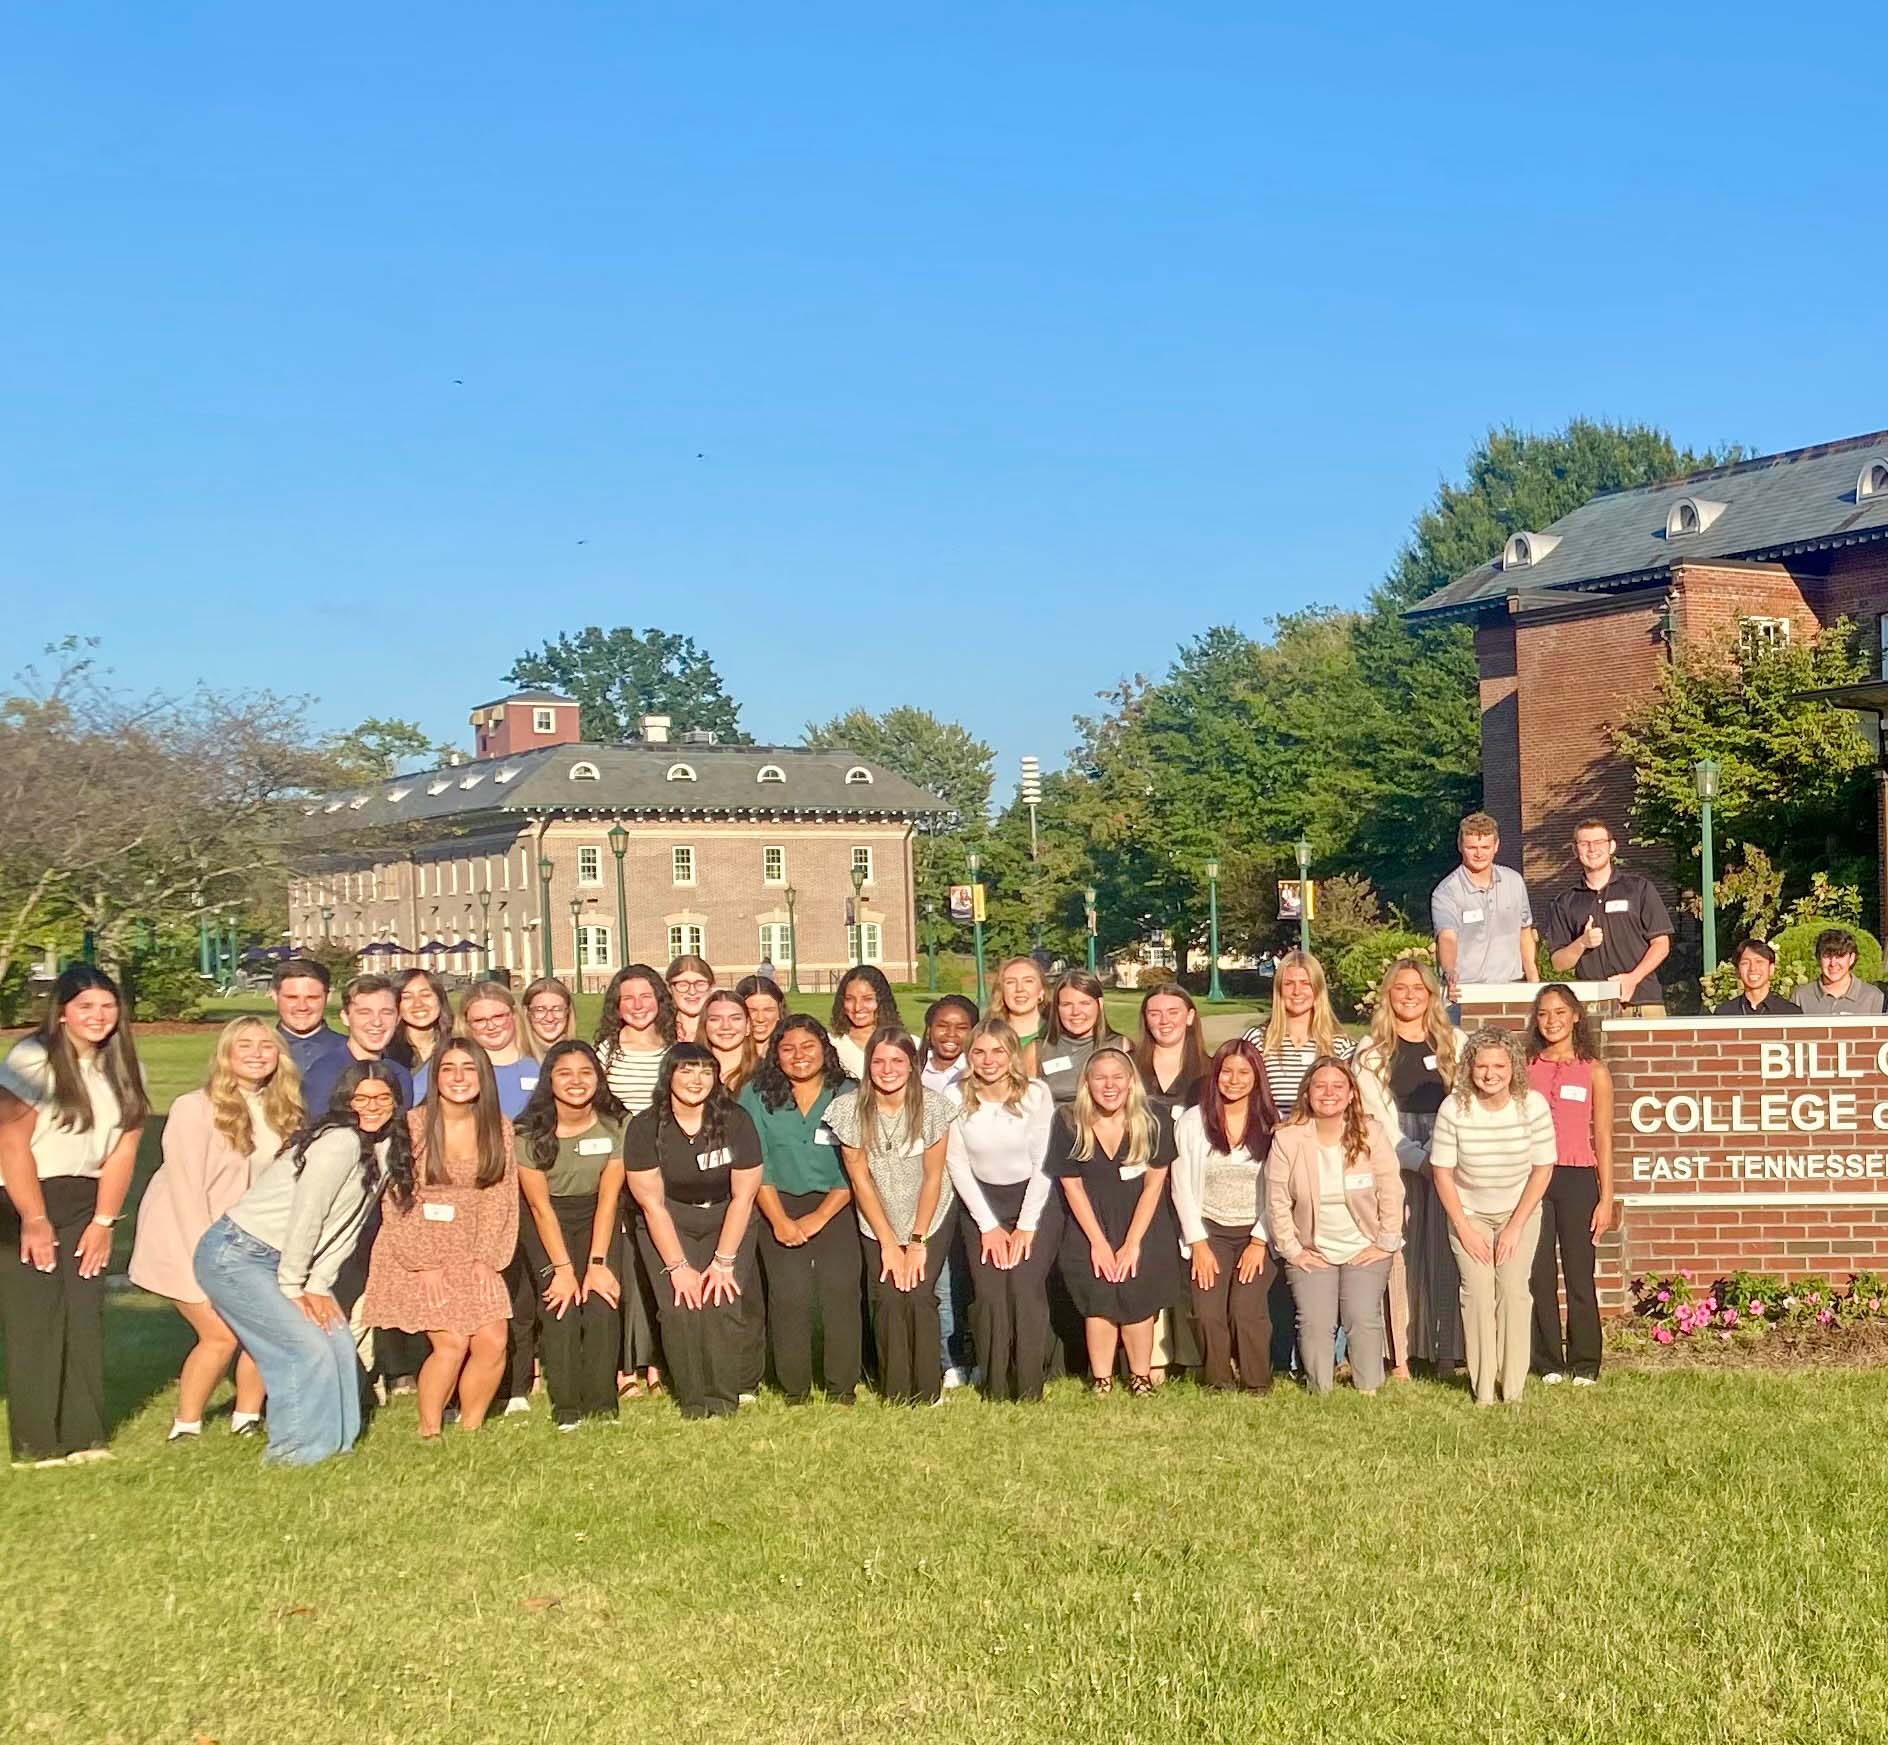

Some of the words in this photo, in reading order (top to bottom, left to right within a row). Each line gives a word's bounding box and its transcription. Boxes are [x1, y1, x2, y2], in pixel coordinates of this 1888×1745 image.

[1760, 1042, 1864, 1079] BILL
[1630, 1094, 1858, 1133] COLLEGE
[1632, 1156, 1710, 1181] EAST
